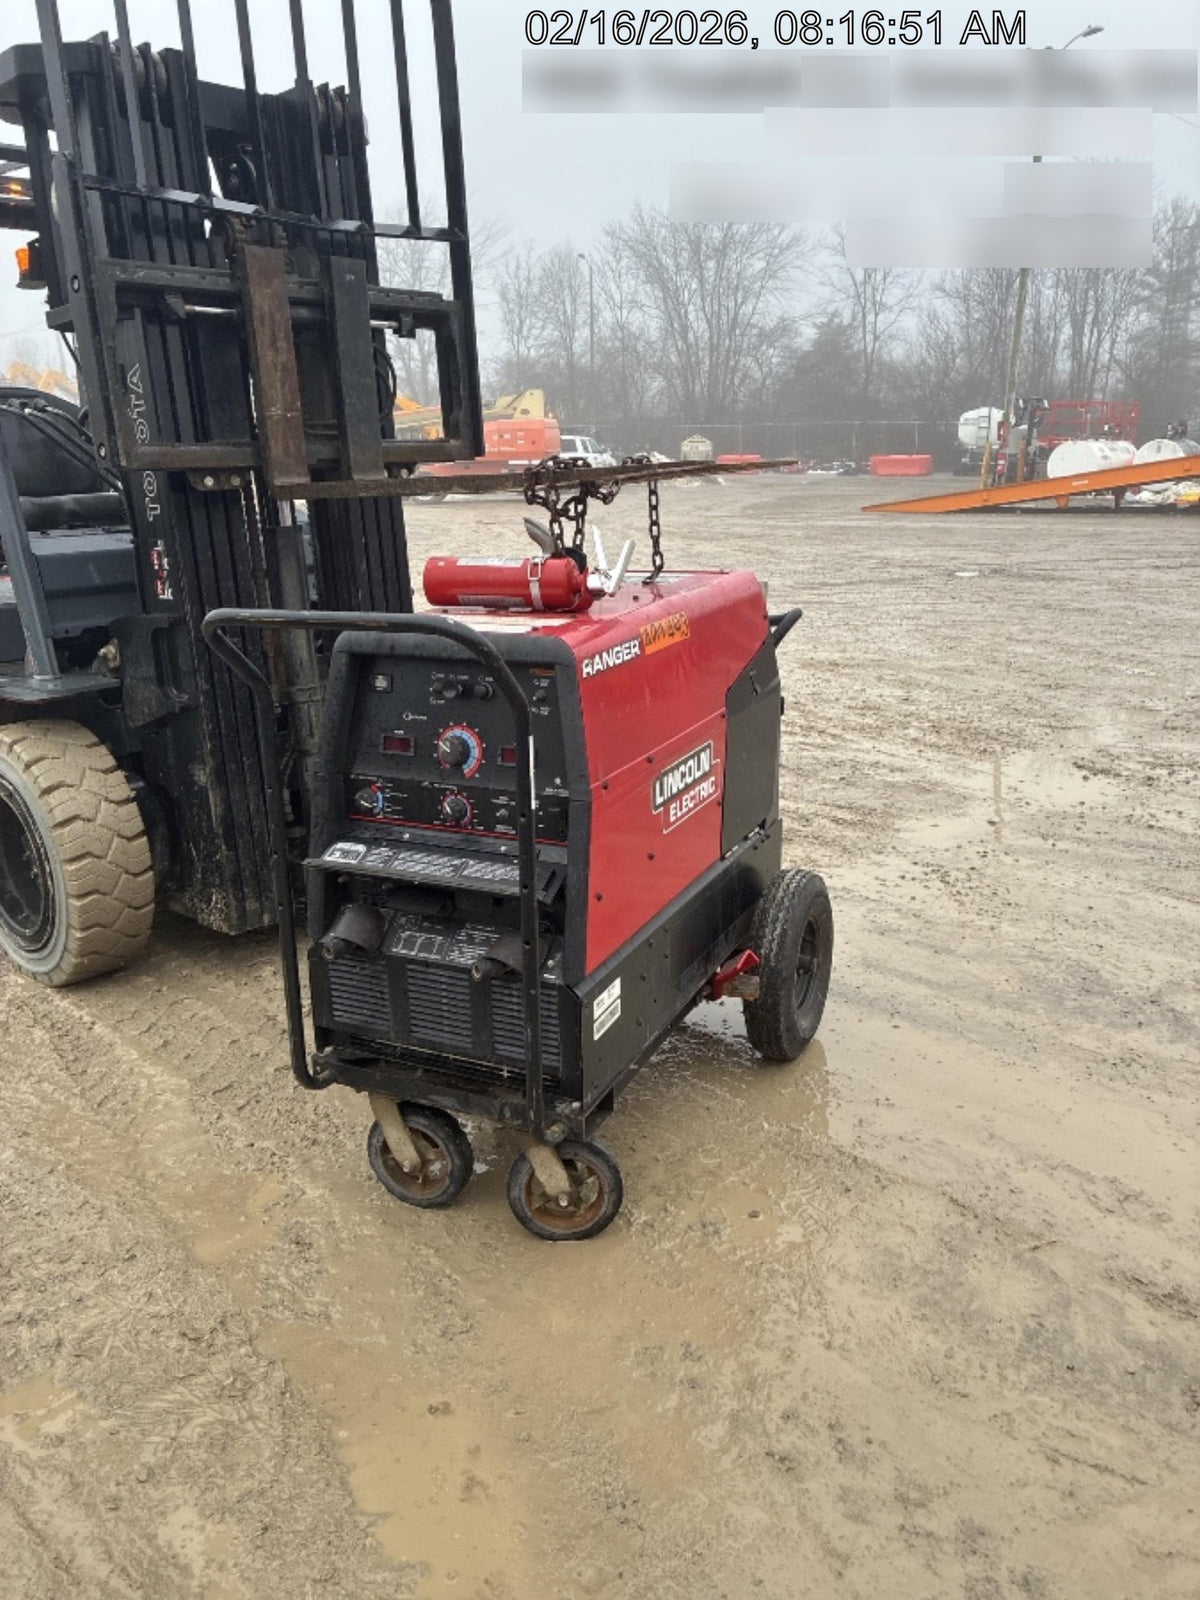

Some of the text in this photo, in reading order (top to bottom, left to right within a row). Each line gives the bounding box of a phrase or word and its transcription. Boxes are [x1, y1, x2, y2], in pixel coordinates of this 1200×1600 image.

[127, 363, 161, 522] TOOTA
[582, 638, 641, 678] RANGER
[655, 748, 710, 806] LINCOLN
[669, 776, 716, 823] ELECTRIC
